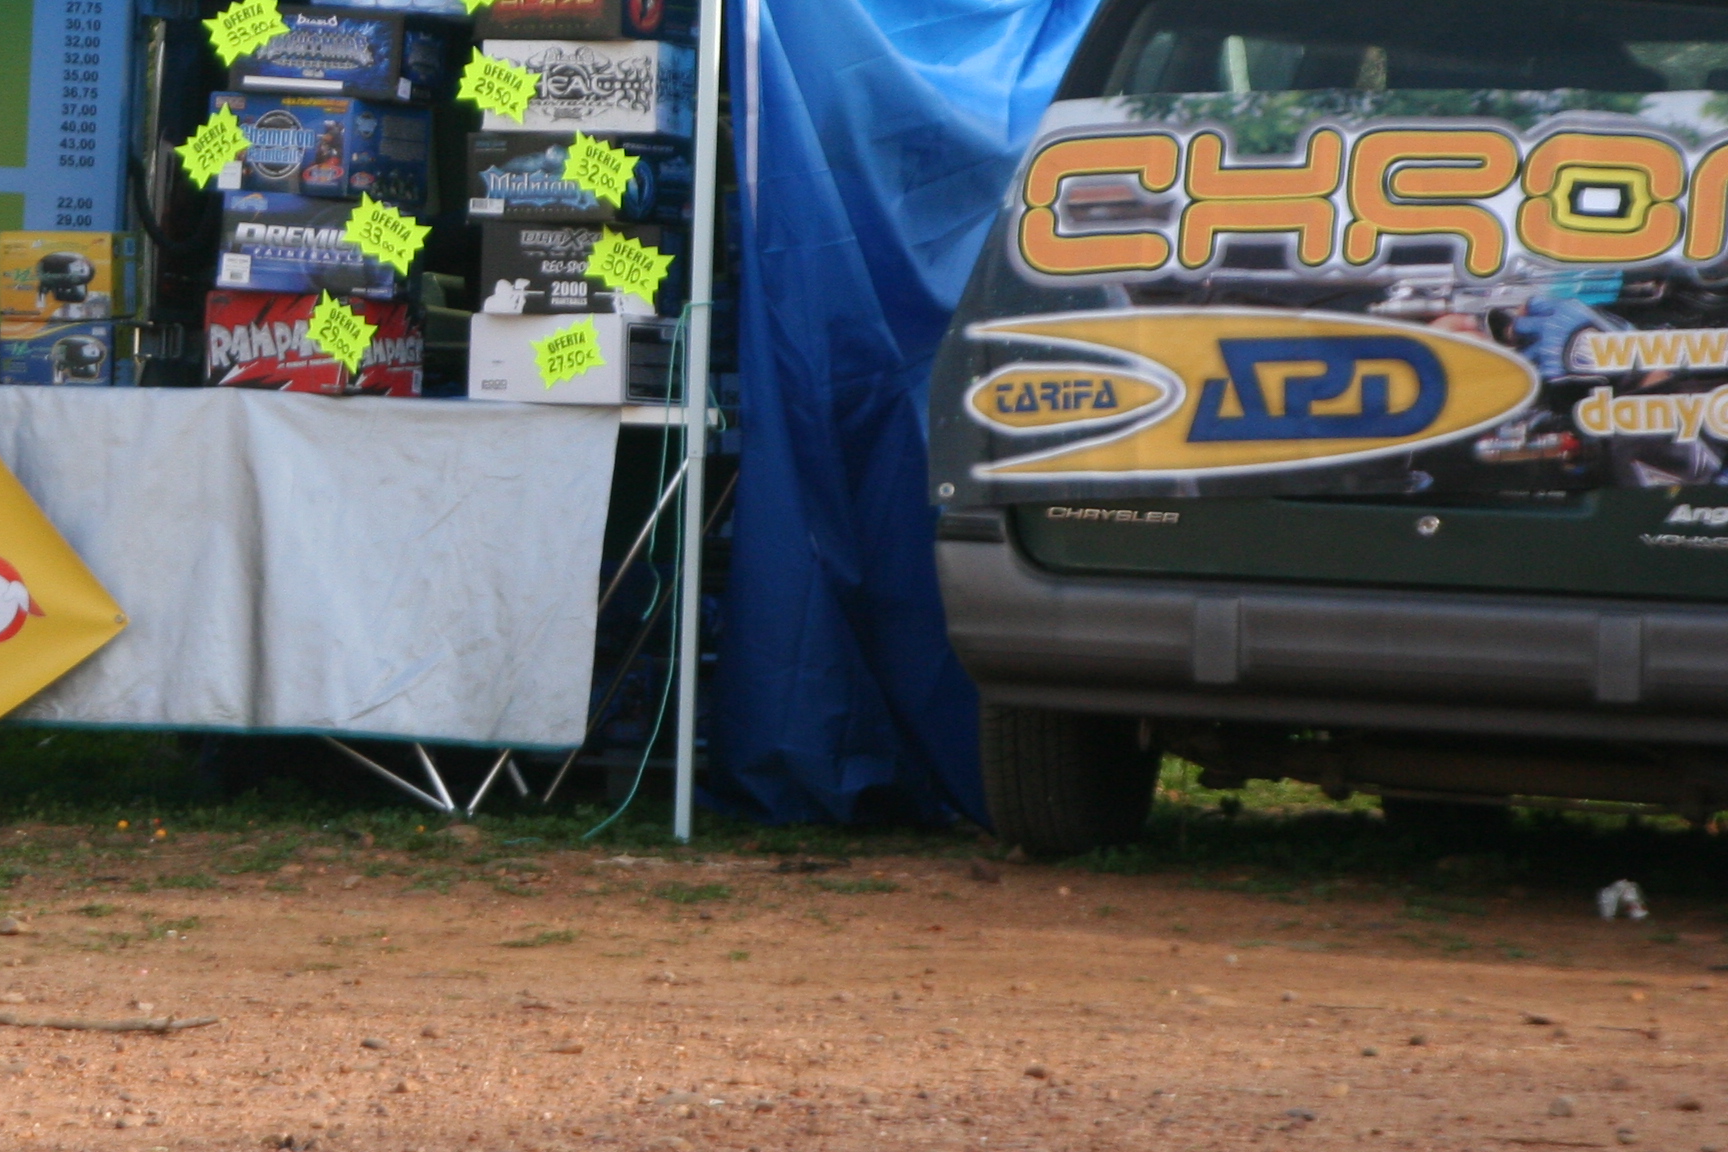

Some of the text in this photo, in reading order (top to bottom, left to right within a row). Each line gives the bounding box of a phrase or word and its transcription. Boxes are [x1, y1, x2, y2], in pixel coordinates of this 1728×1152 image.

[66, 1, 102, 15] 27,75
[224, 3, 264, 29] OFERTA
[65, 18, 101, 32] 30,10
[64, 35, 100, 49] 32,00
[63, 52, 100, 66] 32,00
[62, 69, 99, 83] 35,00
[483, 64, 522, 90] OFERTA
[62, 86, 98, 100] 36,75
[61, 103, 97, 117] 37,00
[60, 120, 96, 134] 40,00
[193, 121, 228, 154] OFERTA
[242, 123, 315, 148] Champion
[59, 137, 96, 151] 43,00
[58, 154, 95, 168] 55,00
[586, 146, 622, 174] OFERTA
[57, 197, 93, 211] 22,00
[56, 214, 92, 228] 29,00
[371, 209, 412, 242] OFERTA
[254, 248, 364, 262] PAINTBALLS
[613, 241, 653, 272] OFERTA
[541, 259, 588, 273] REC-SPO
[551, 281, 587, 296] 2000
[329, 308, 361, 341] OFERTA
[210, 319, 322, 367] RAMPA
[547, 331, 586, 354] OFERTA
[996, 381, 1120, 413] TARIFA
[1047, 506, 1180, 524] CHRYSLER
